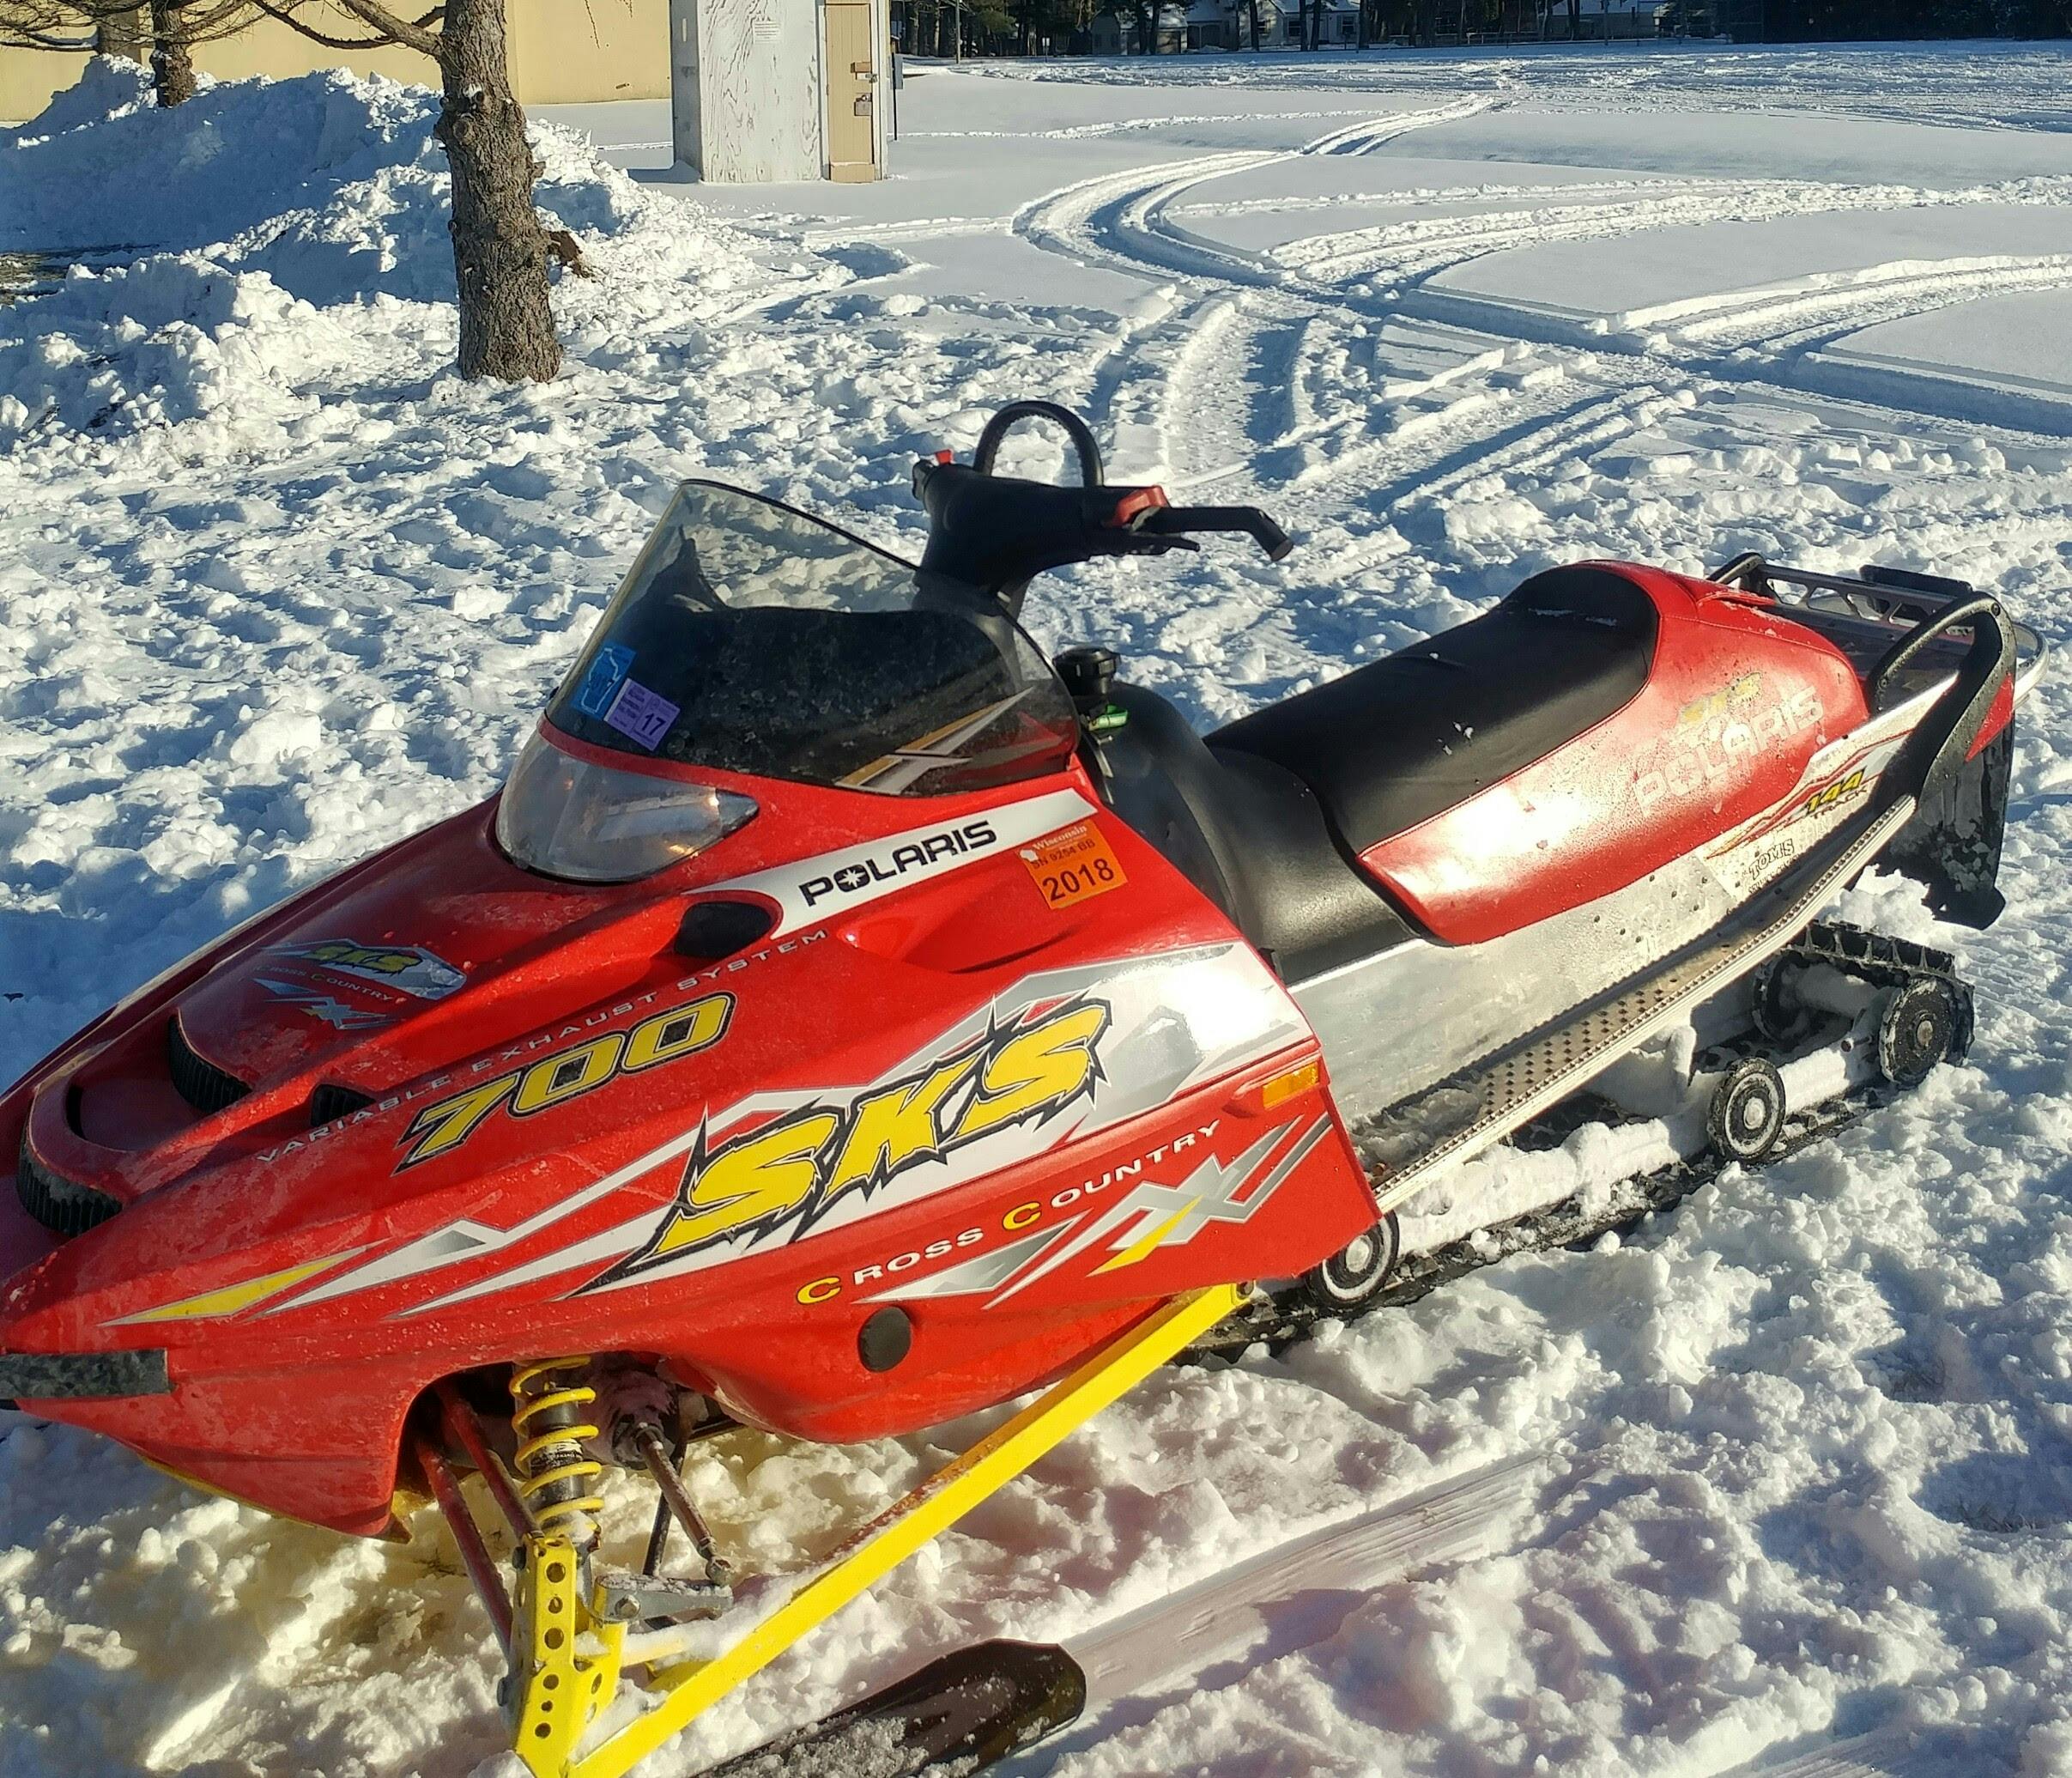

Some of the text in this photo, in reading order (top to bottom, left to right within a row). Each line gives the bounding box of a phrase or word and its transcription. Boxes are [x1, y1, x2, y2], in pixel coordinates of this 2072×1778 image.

[641, 713, 667, 736] 17
[1633, 686, 1823, 813] POLARIS
[1805, 766, 1868, 816] 144
[1813, 787, 1868, 818] TRACK
[798, 821, 997, 907] POLARIS
[1032, 825, 1087, 851] Wisconsin
[1042, 858, 1114, 901] 2018
[257, 928, 827, 1163] VARIABLE EXHAUST SYSTEM
[391, 991, 737, 1177] 700
[637, 996, 1114, 1269] SKS
[796, 1120, 1221, 1305] CROSS COUNTRY
